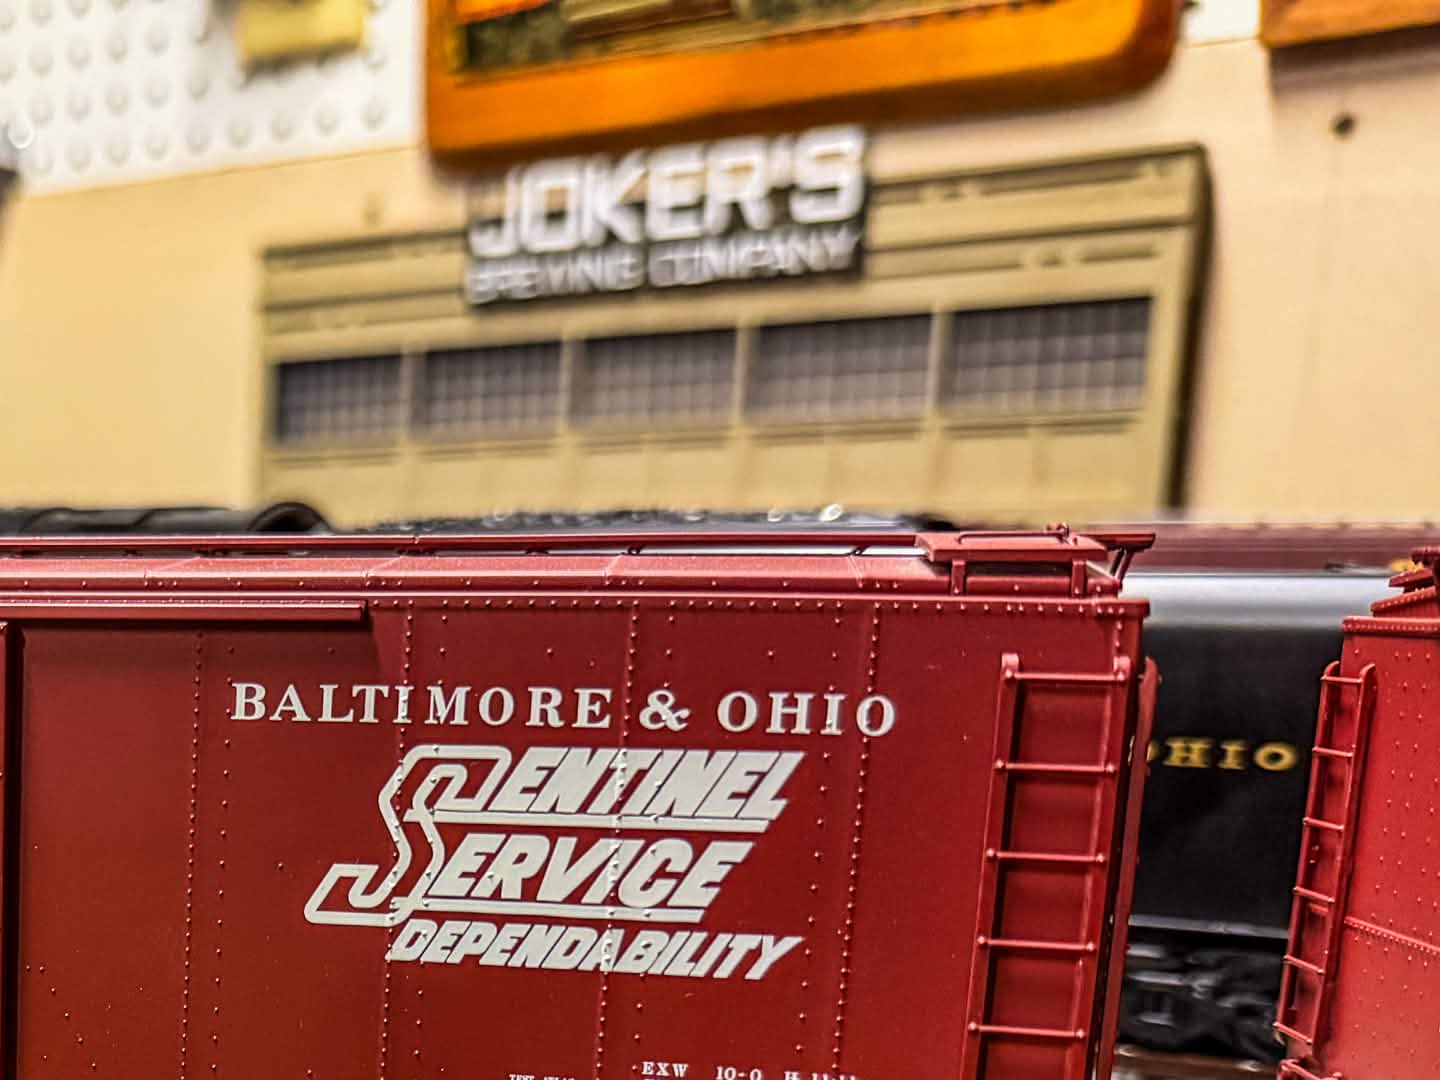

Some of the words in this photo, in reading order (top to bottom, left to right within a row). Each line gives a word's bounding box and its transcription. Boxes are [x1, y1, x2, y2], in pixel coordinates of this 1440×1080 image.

[468, 125, 864, 256] JOKER'S
[649, 225, 861, 288] COMPANY
[227, 682, 612, 730] BALTIMORE
[639, 688, 691, 731] &
[717, 690, 896, 738] OHIO
[1147, 736, 1298, 772] HIO
[385, 919, 804, 981] DEPENDABILITY
[641, 1061, 688, 1078] EXW
